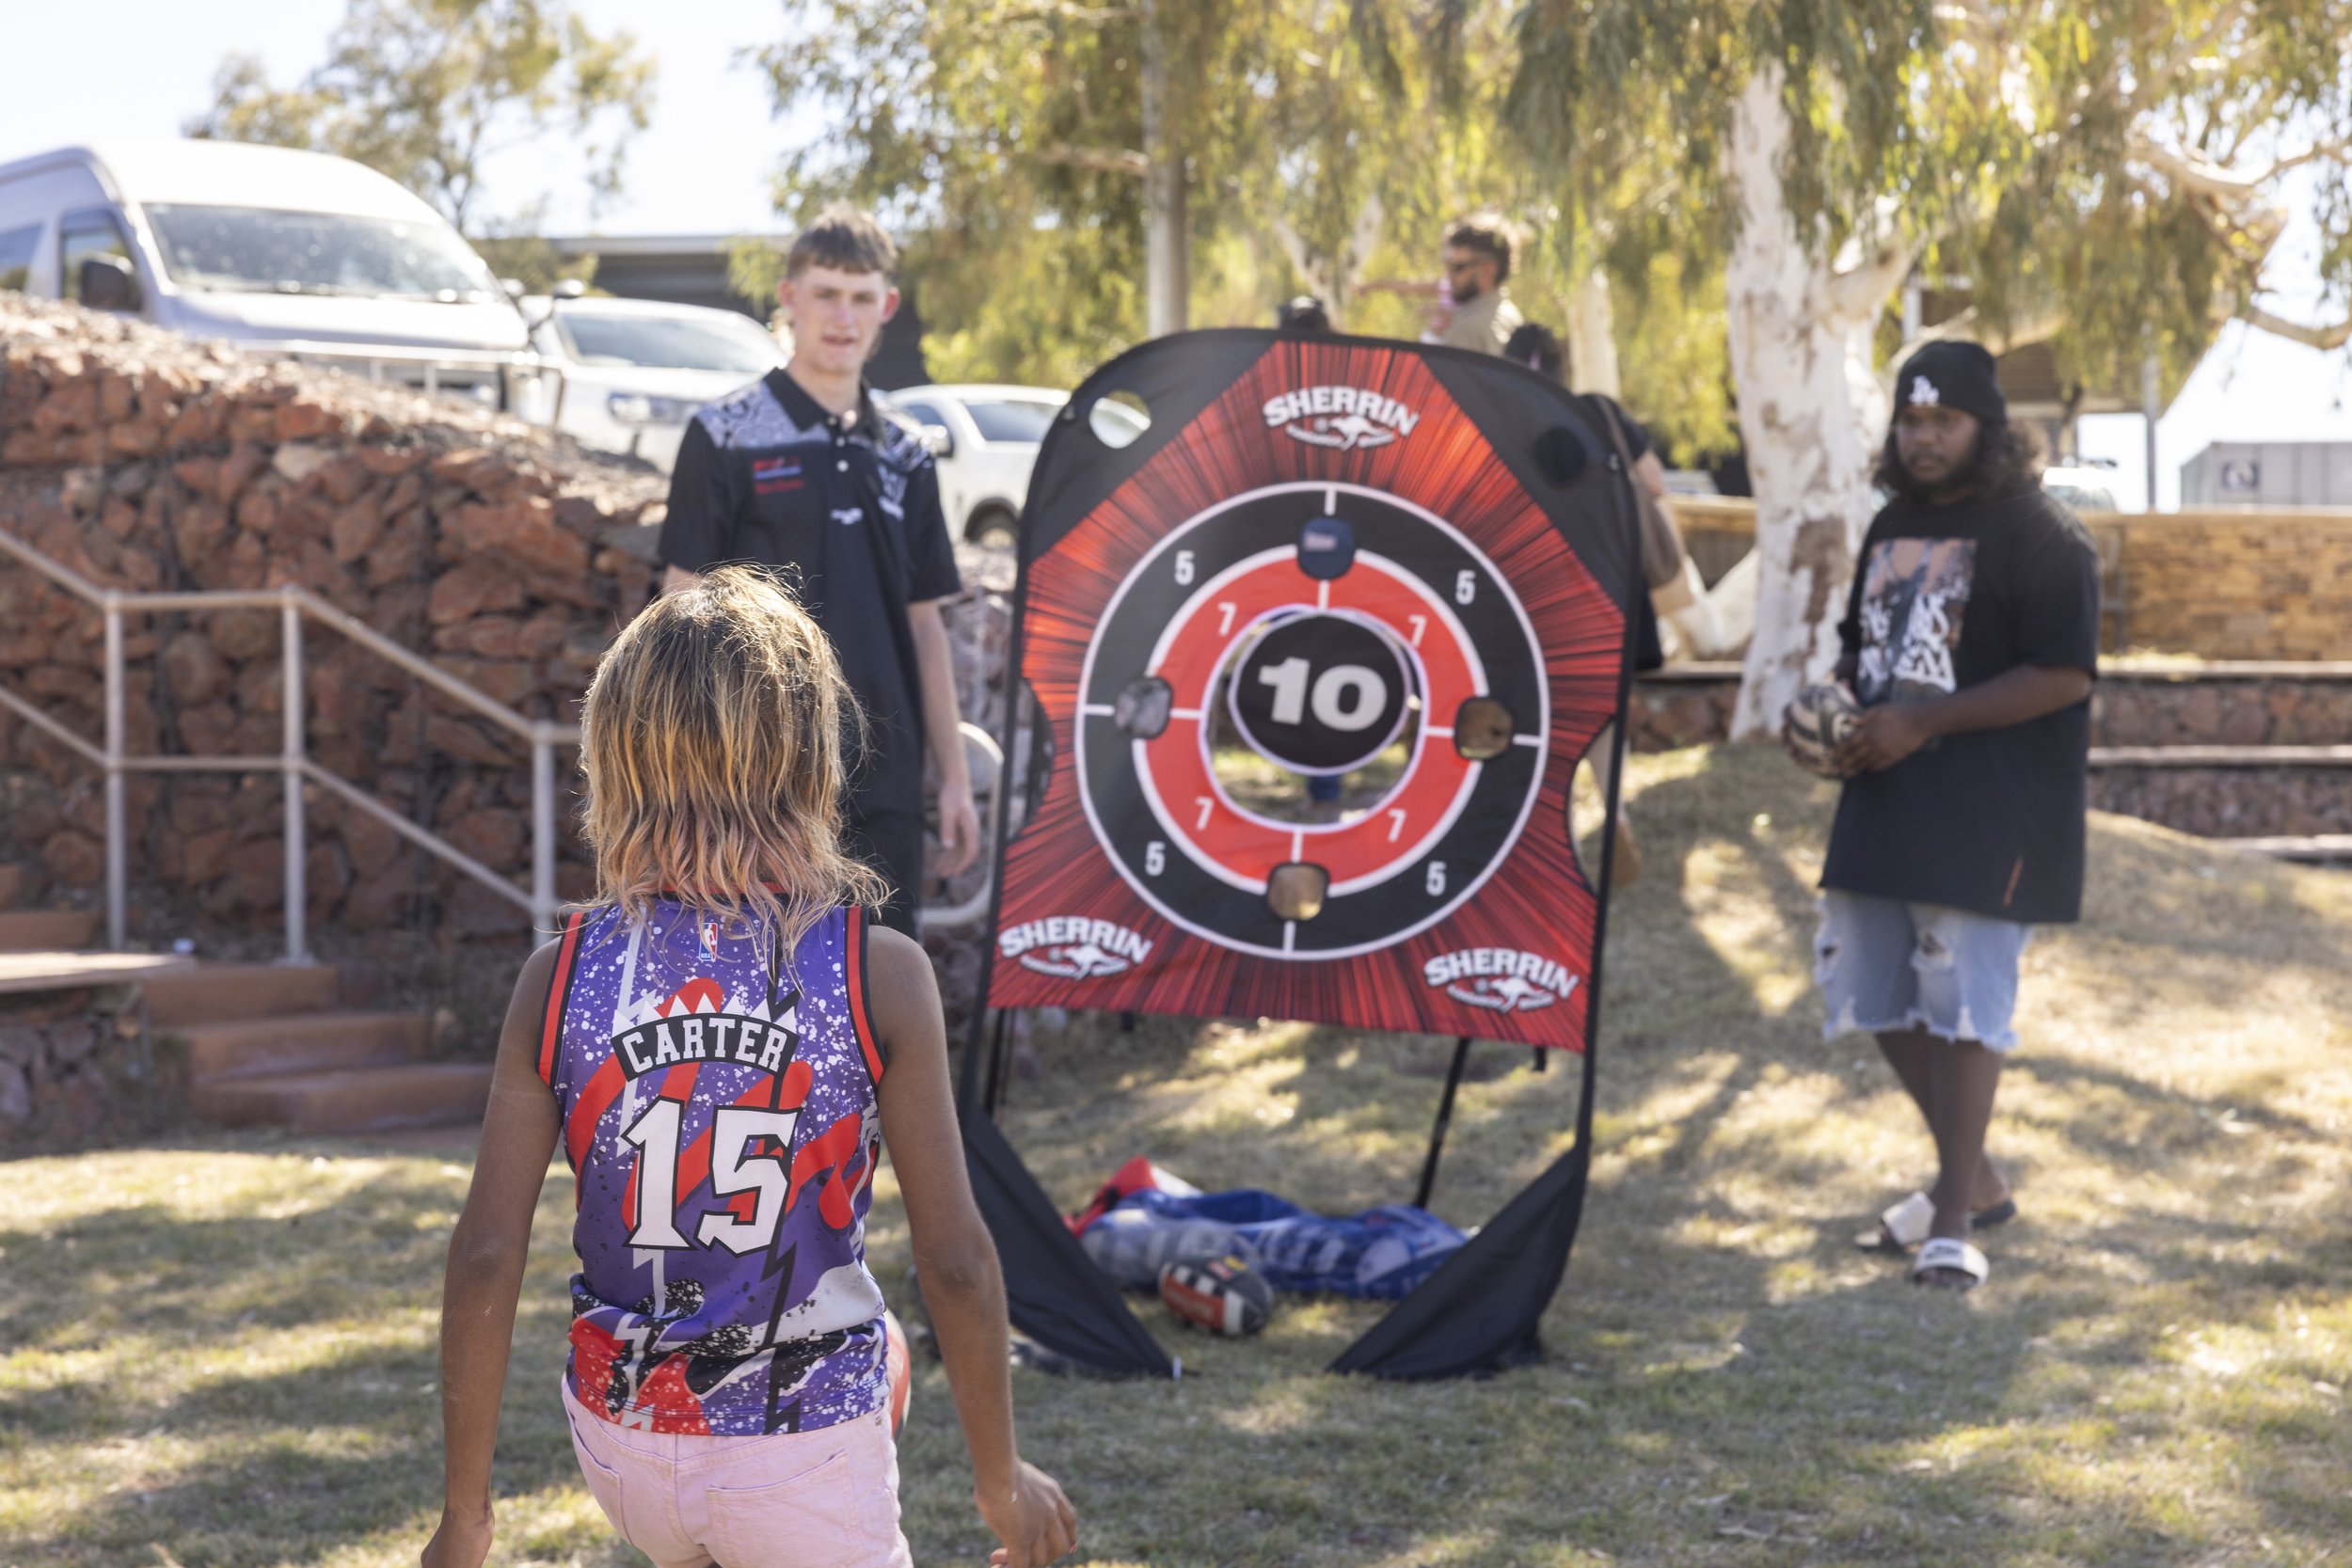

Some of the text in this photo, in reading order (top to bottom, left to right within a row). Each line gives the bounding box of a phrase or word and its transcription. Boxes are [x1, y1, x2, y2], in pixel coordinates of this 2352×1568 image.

[1263, 385, 1419, 437] SHERRIN
[1174, 549, 1195, 586] 5
[1454, 569, 1476, 606] 5
[1217, 601, 1237, 637] 7
[1407, 613, 1428, 649] 7
[1258, 656, 1388, 732] 10
[1196, 796, 1215, 831] 7
[1388, 808, 1406, 843] 7
[1145, 841, 1166, 877] 5
[1425, 860, 1447, 896] 5
[998, 915, 1153, 964] SHERRIN
[1423, 947, 1579, 999] SHERRIN
[621, 1017, 789, 1074] CARTER
[621, 1095, 803, 1257] 15
